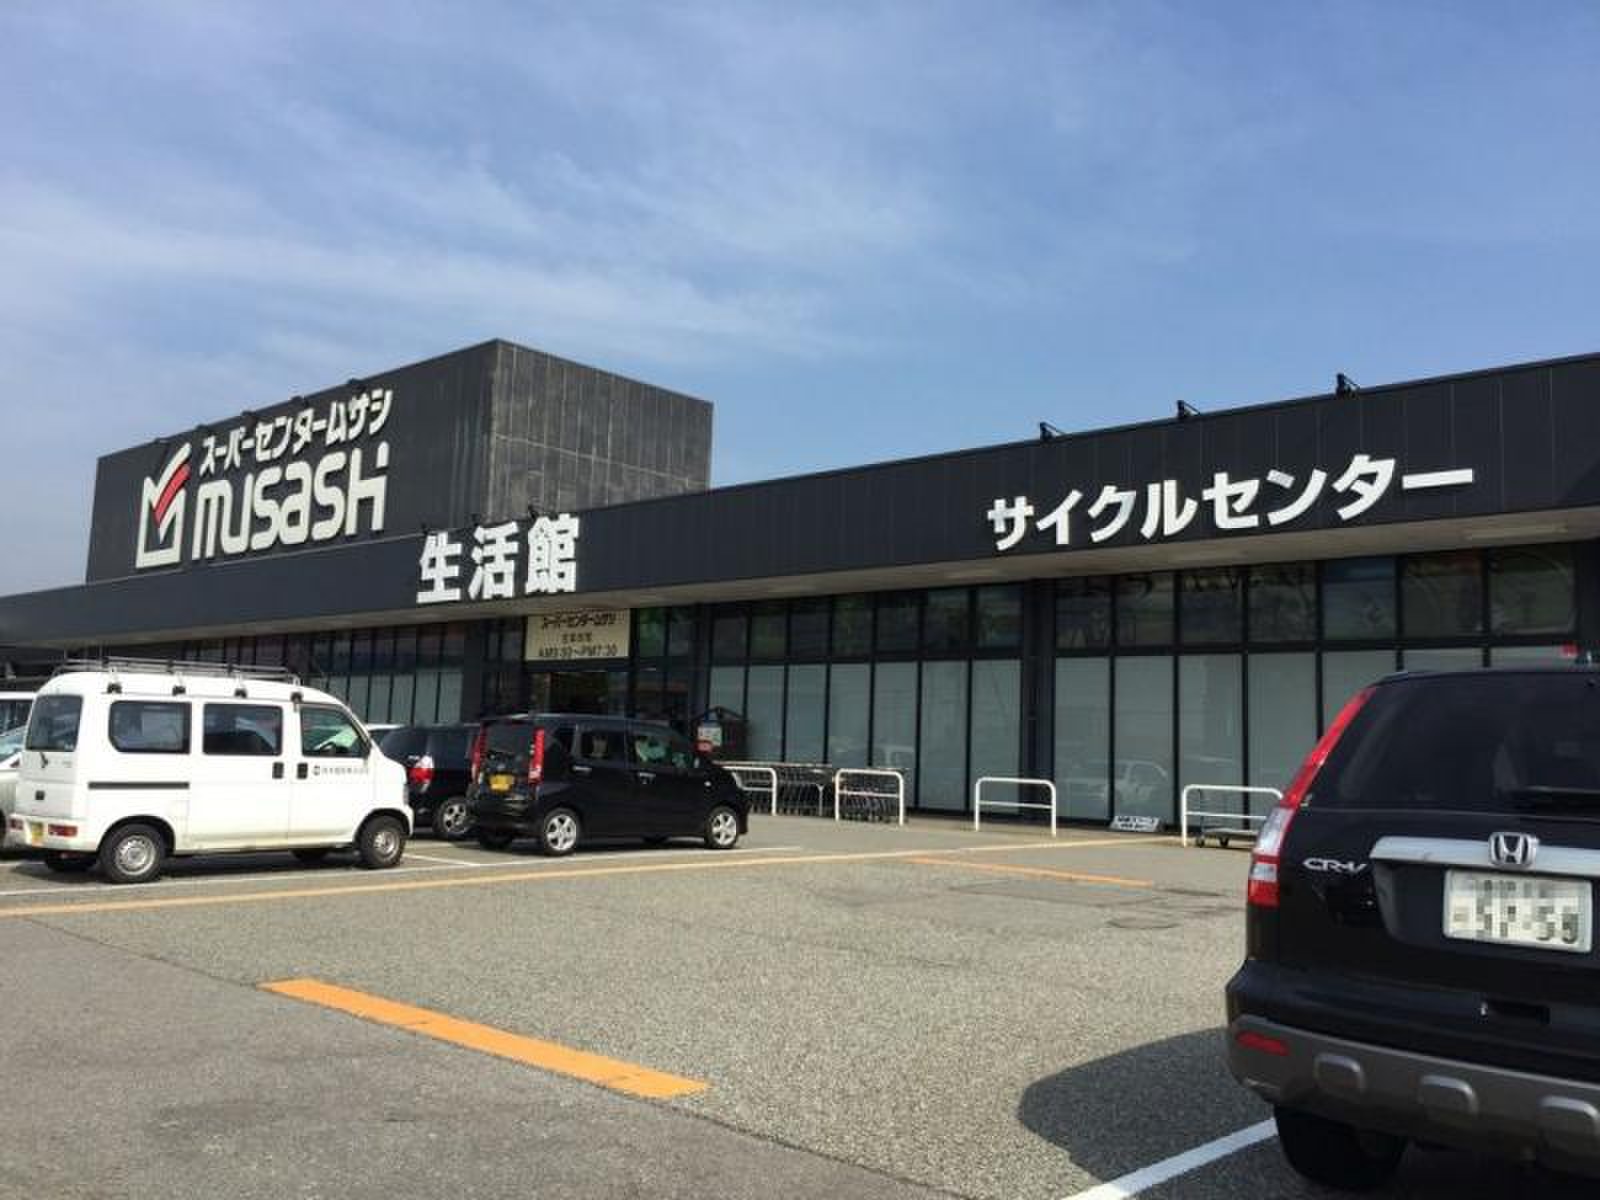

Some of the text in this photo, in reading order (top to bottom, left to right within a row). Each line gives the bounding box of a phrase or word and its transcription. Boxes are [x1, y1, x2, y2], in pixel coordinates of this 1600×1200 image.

[199, 389, 393, 476] スーパーセンタームサシ
[987, 454, 1473, 551] サイクルセンター
[416, 512, 579, 603] 生活館
